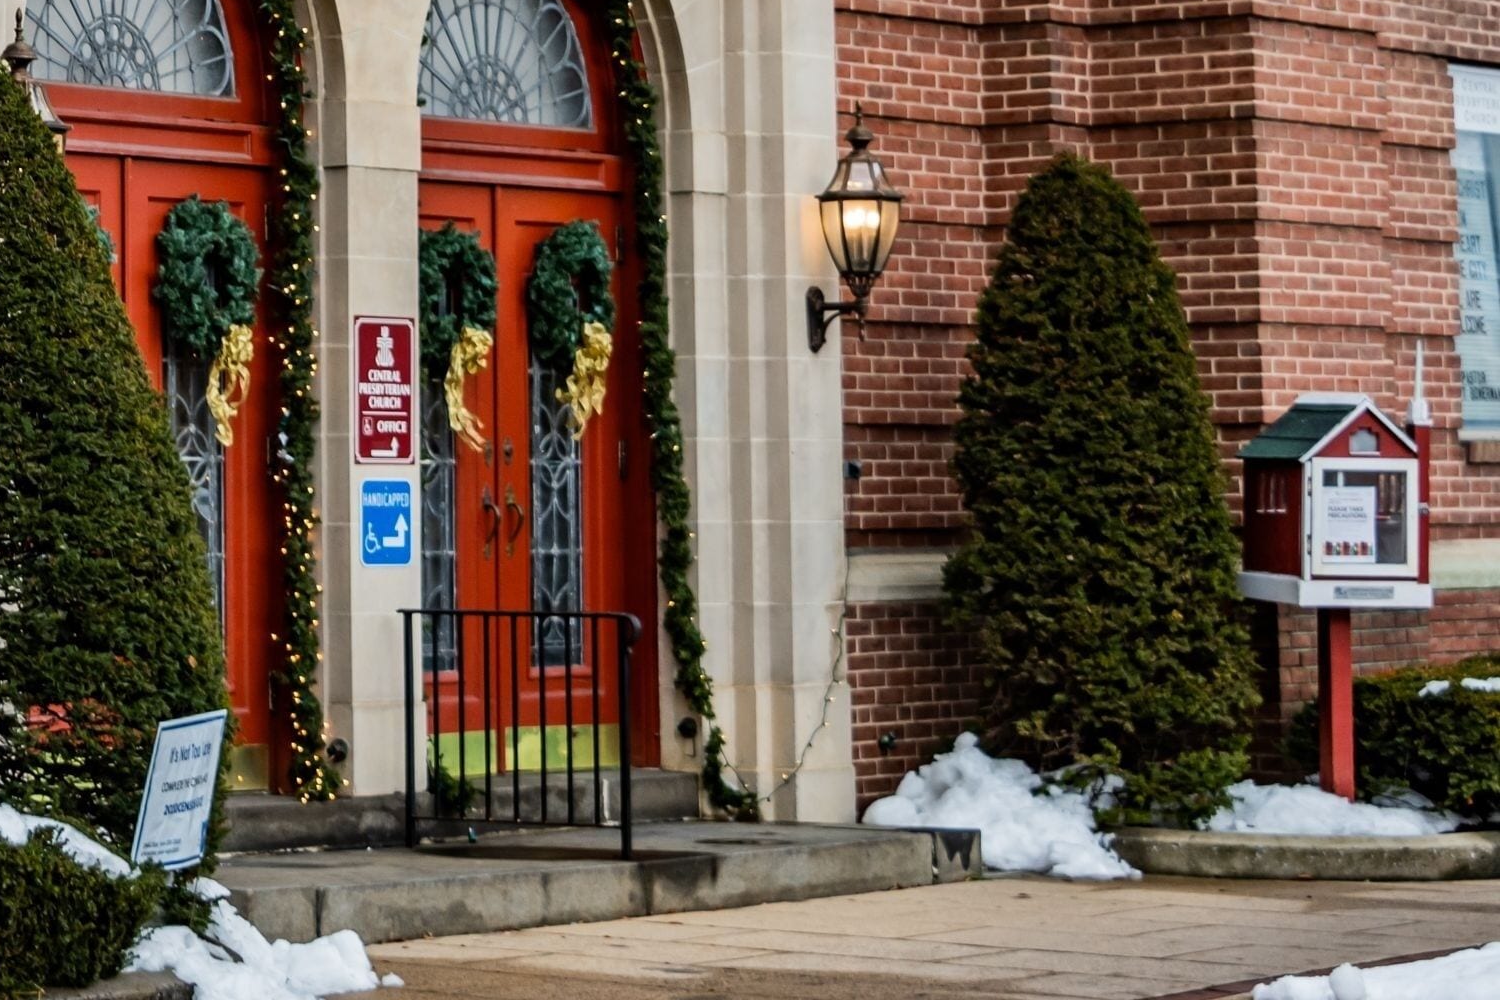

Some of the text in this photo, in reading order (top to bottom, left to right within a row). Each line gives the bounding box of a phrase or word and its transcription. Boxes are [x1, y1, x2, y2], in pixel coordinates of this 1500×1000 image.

[368, 369, 401, 383] CENTRAL
[359, 382, 410, 396] PRESBYTERIAN
[368, 396, 401, 409] CHURCH
[377, 420, 407, 433] OFFICE
[362, 492, 409, 507] HANDICAPPED
